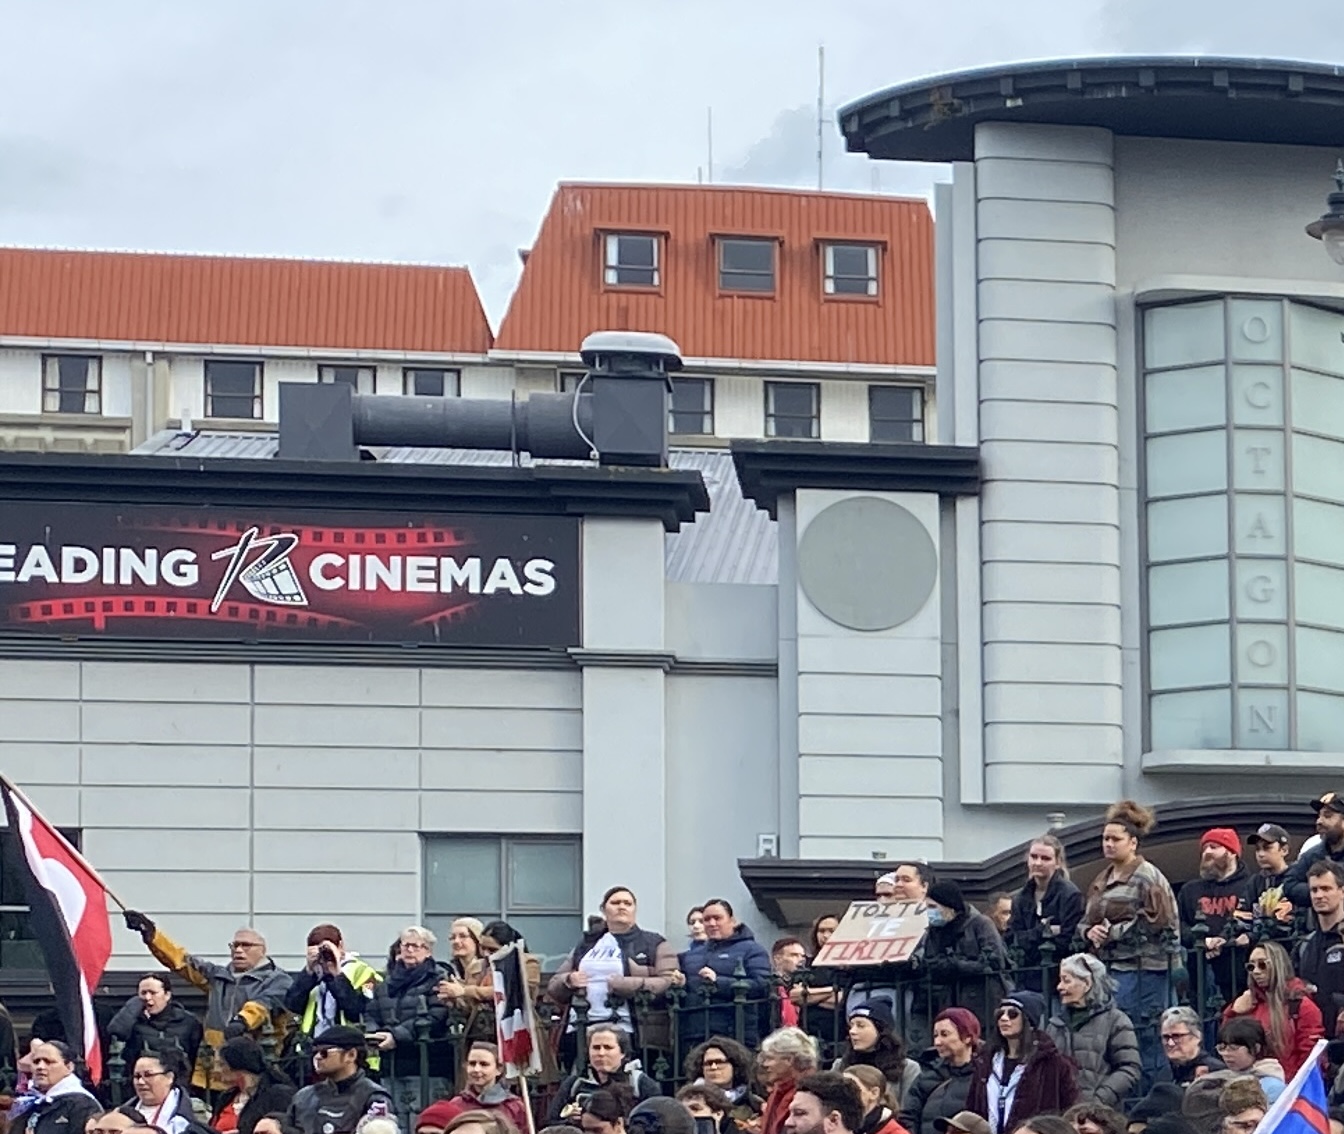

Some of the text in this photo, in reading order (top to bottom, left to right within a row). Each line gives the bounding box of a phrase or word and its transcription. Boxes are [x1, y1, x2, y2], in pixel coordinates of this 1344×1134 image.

[1242, 315, 1278, 734] OCTAGON
[309, 552, 556, 597] CINEMAS
[867, 918, 904, 938] TE
[822, 936, 919, 961] TIRITI
